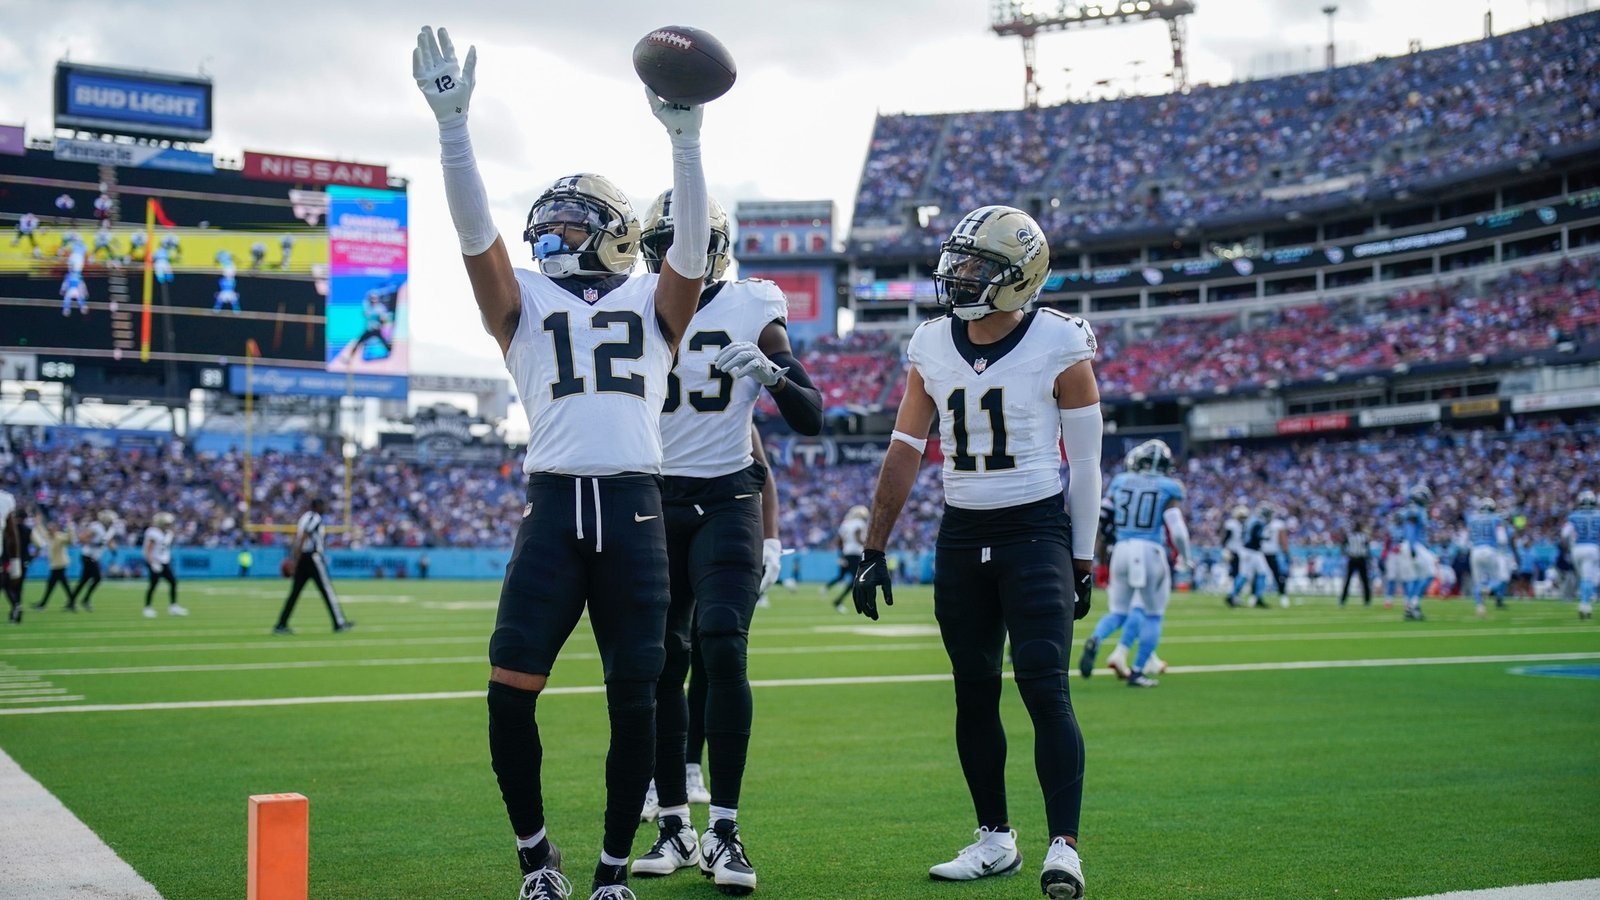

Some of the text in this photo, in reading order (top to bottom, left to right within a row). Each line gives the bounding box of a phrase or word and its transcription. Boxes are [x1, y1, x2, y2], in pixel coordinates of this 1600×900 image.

[75, 85, 198, 118] BUD LIGHT
[434, 74, 456, 93] 12
[260, 157, 373, 184] NISSAN
[541, 310, 646, 401] 12
[946, 385, 1018, 474] 11
[1114, 489, 1159, 529] 30
